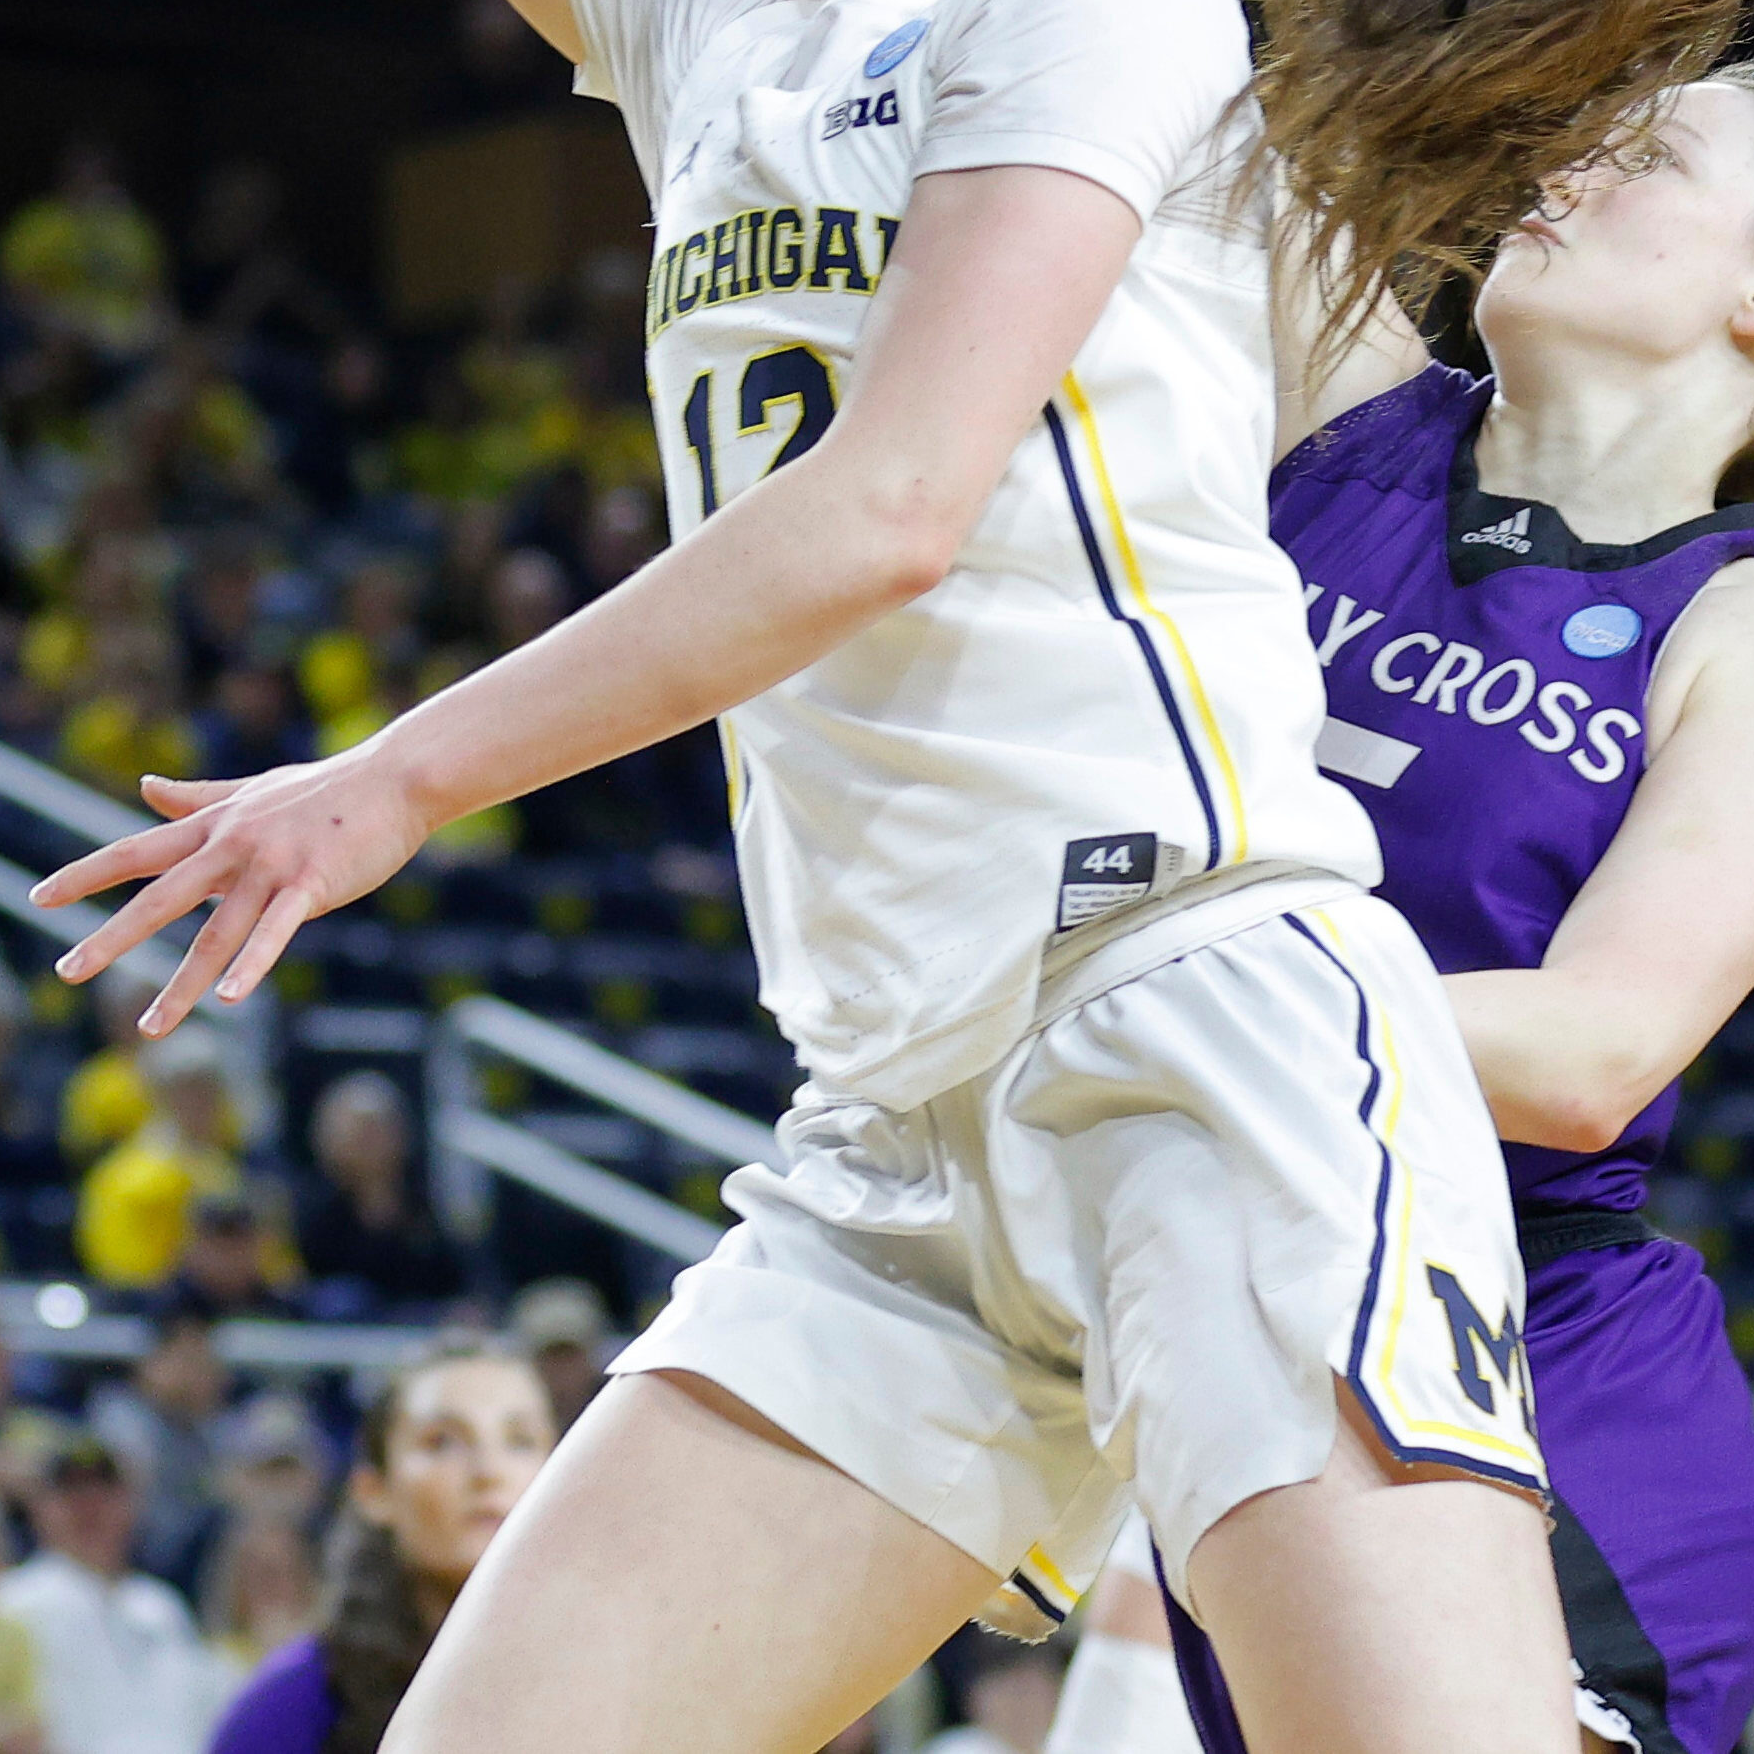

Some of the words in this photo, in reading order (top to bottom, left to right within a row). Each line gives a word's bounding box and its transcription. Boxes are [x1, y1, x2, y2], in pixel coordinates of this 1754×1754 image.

[1370, 631, 1642, 784] CROSS
[1081, 844, 1134, 875] 44
[1423, 1257, 1538, 1442] M
